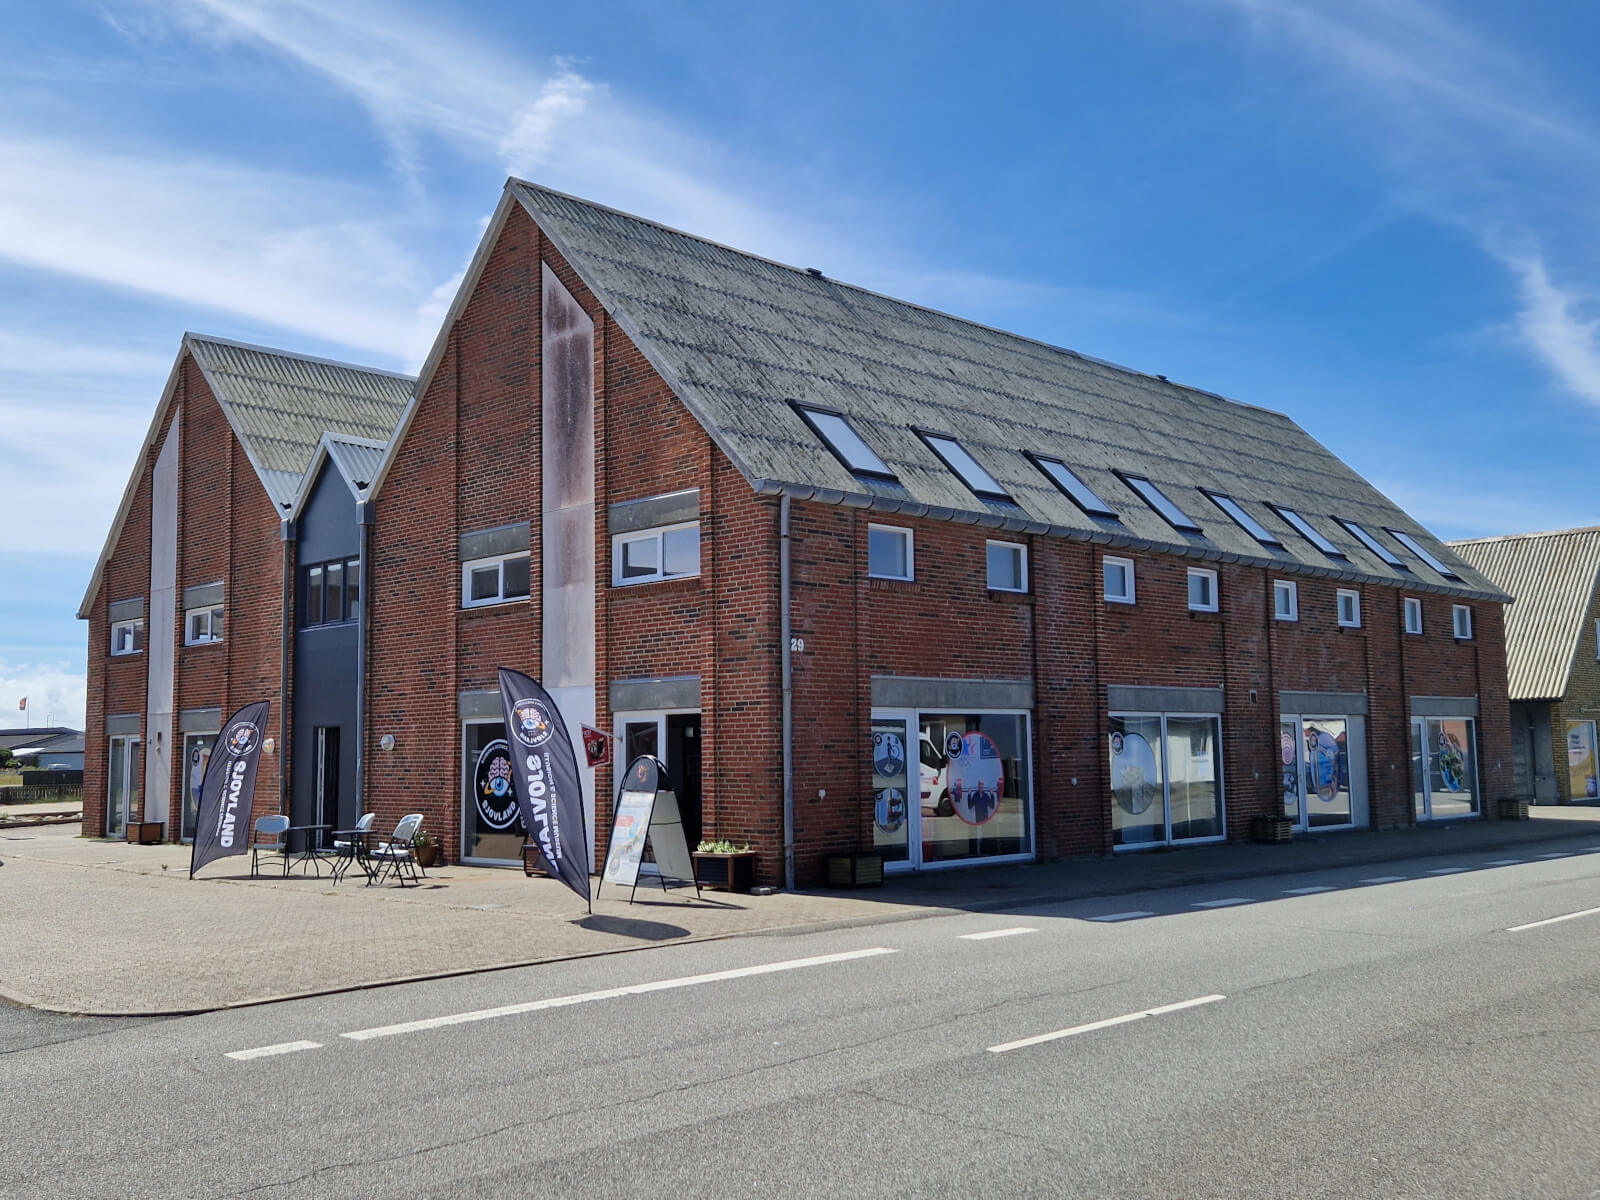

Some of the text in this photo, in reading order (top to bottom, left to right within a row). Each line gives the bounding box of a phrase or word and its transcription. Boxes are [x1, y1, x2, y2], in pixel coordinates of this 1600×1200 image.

[790, 638, 805, 652] 29
[220, 761, 246, 848] SJOVLAND
[482, 799, 516, 822] SJOVLAND
